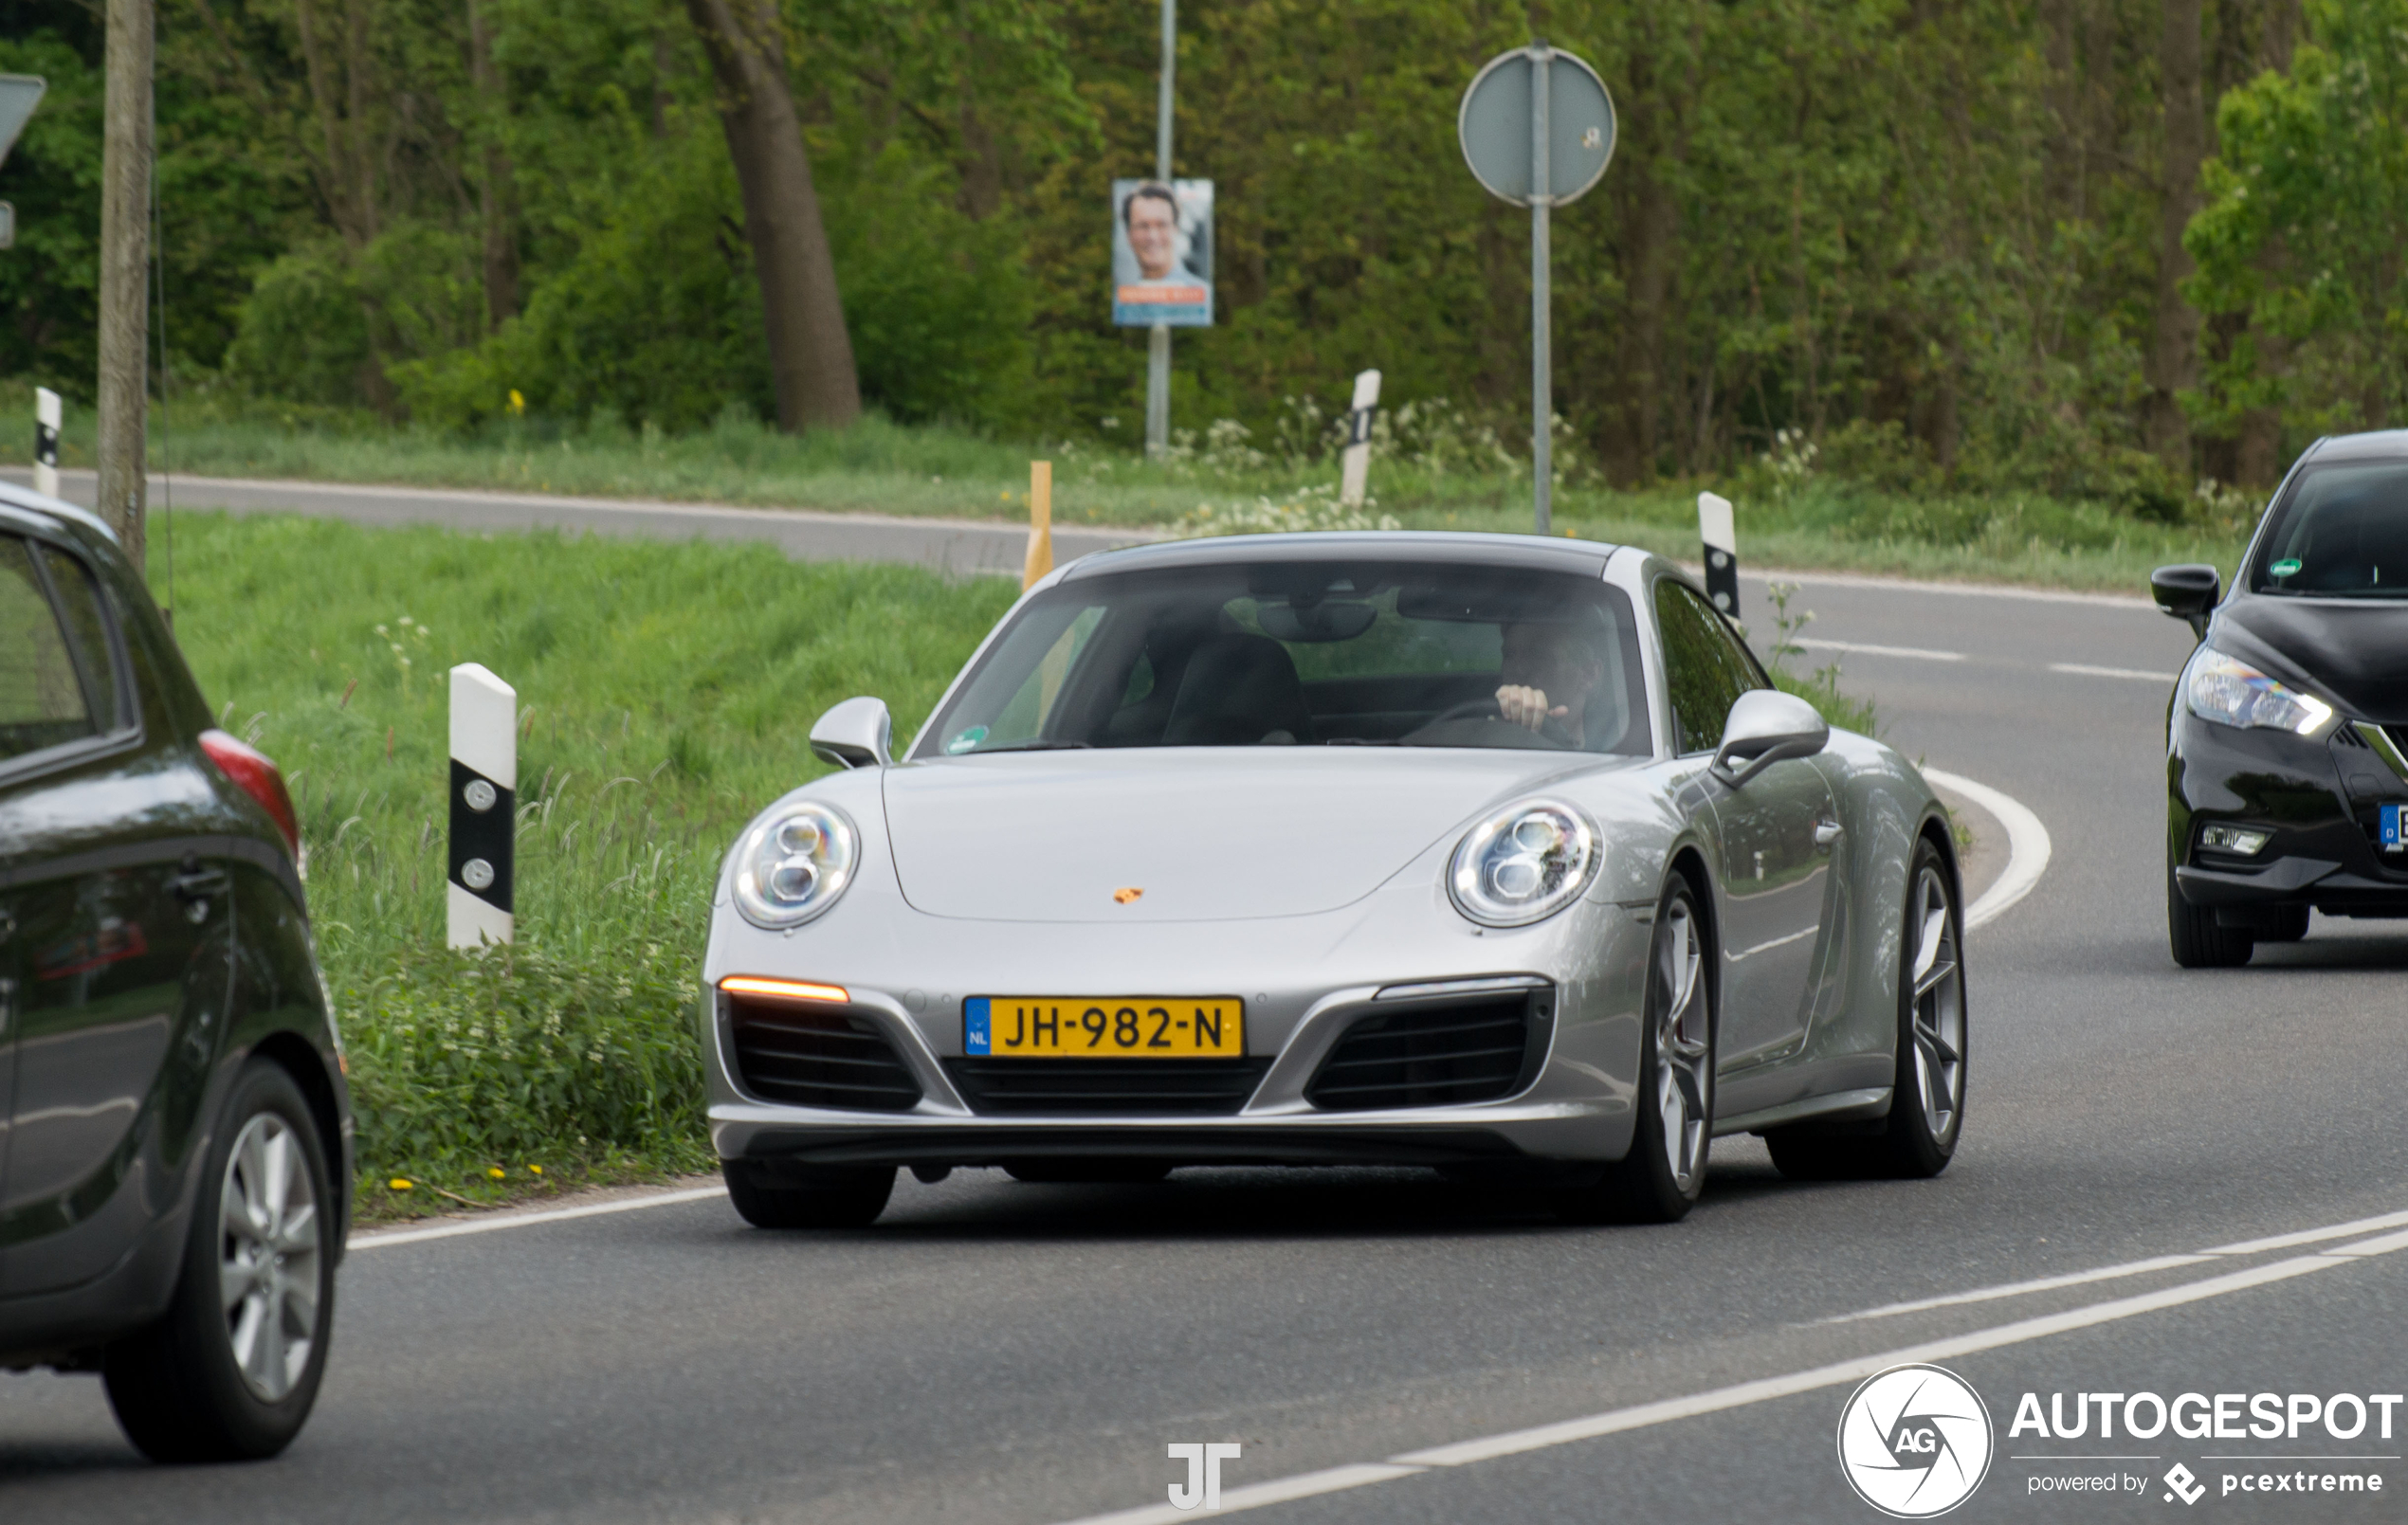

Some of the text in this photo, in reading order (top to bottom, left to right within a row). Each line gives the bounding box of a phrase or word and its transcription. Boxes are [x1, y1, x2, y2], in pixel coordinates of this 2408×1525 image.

[2386, 828, 2394, 839] D
[969, 1008, 1221, 1047] NL JH-982-N
